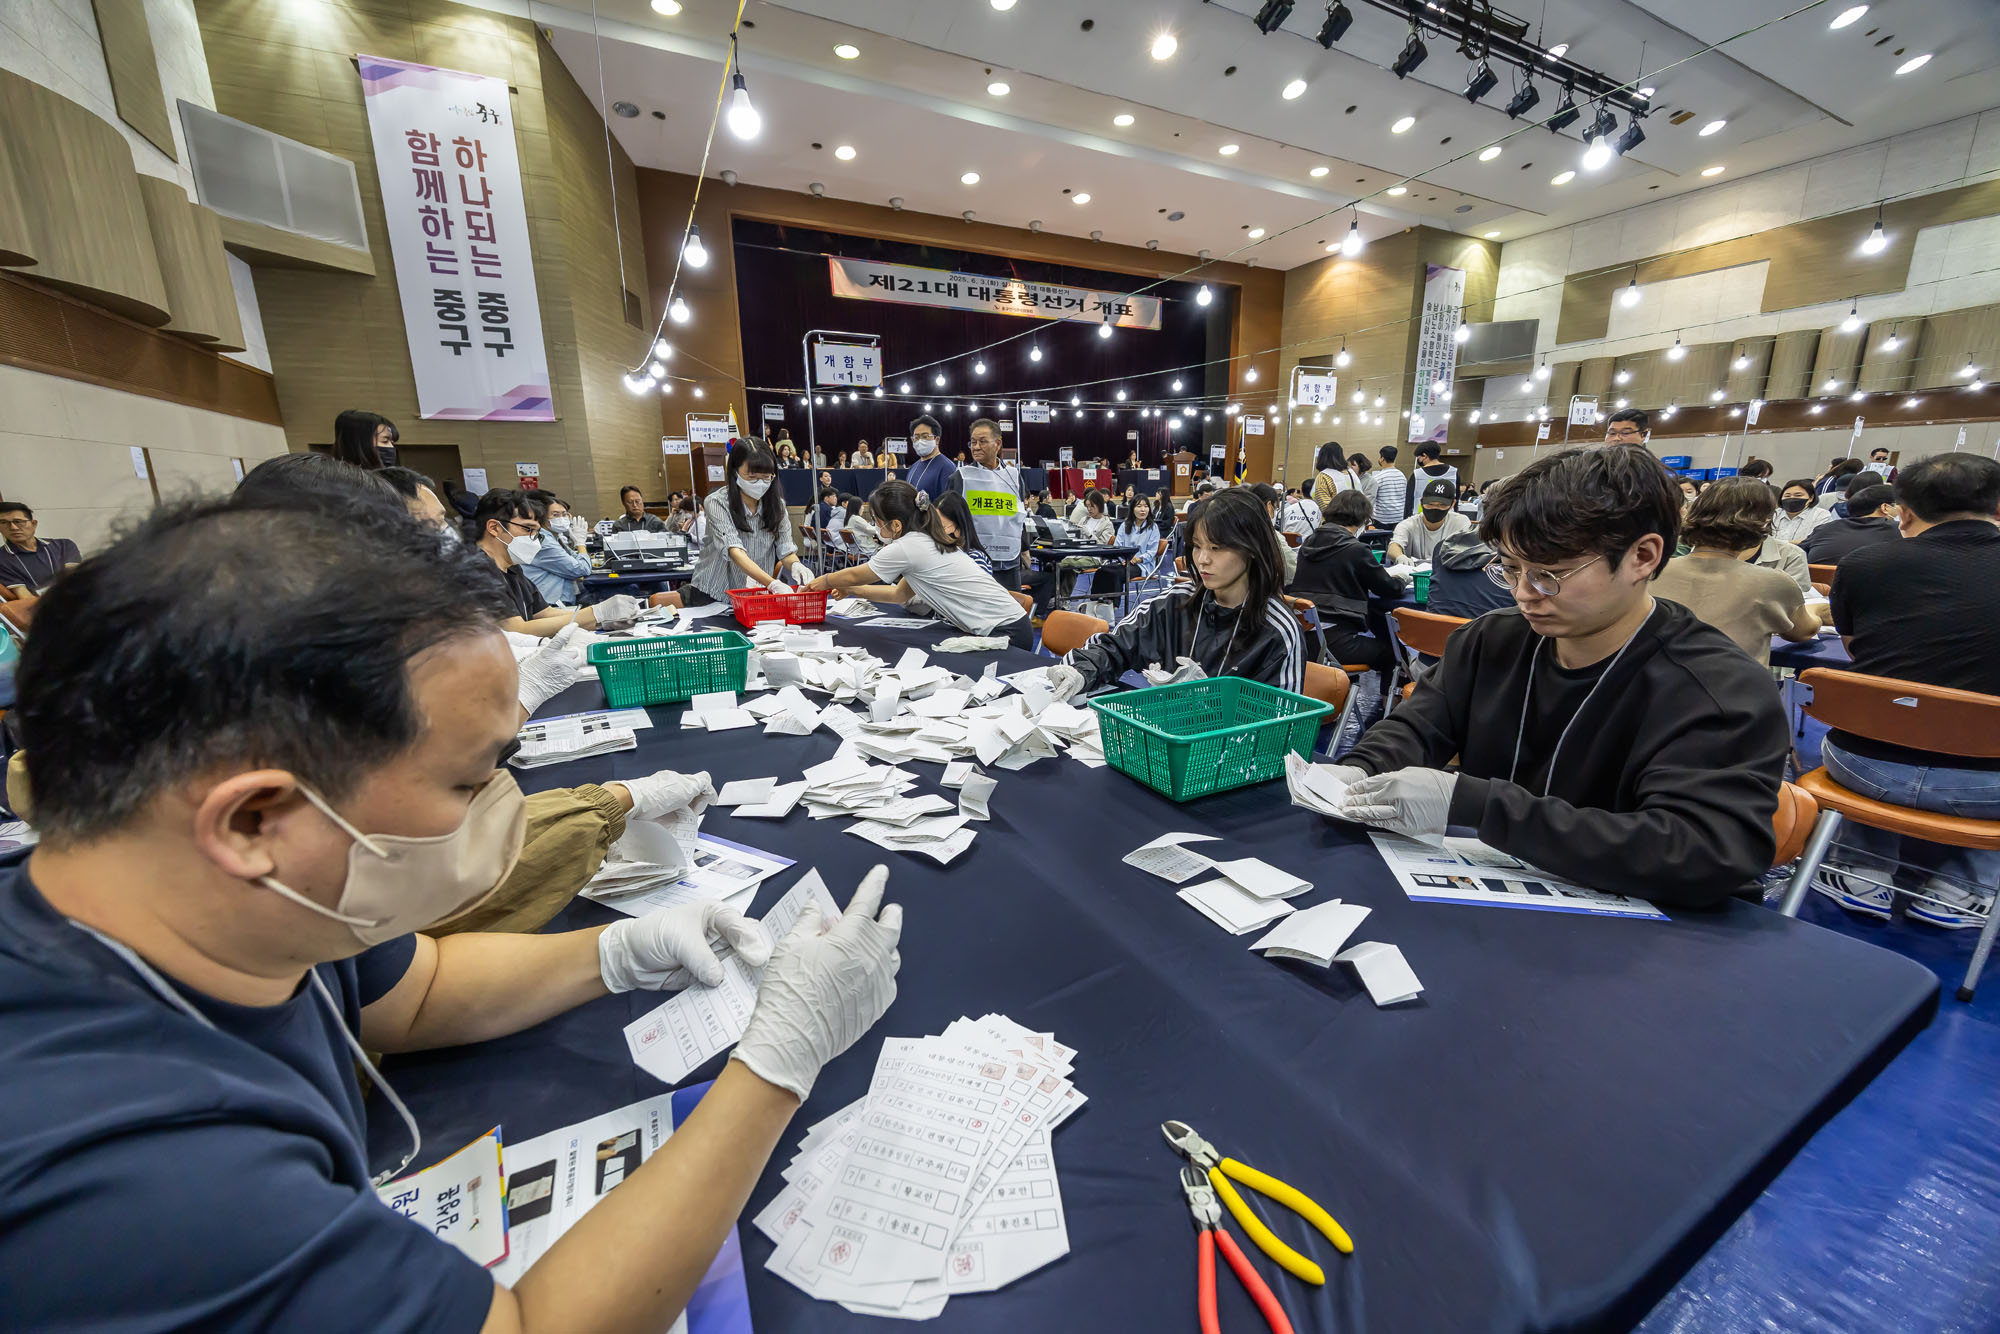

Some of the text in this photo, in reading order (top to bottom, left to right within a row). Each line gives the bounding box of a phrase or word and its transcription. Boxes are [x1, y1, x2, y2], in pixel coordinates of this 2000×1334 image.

[404, 129, 472, 356] 함께하는 중구
[452, 136, 502, 279] 하나되는
[477, 291, 514, 357] 중구
[868, 273, 1134, 317] 제21대 대통령선거 개표
[824, 354, 873, 370] 개함부
[972, 497, 1014, 510] 개표참관
[1435, 484, 1445, 494] NY
[435, 1184, 460, 1235] 김성훈
